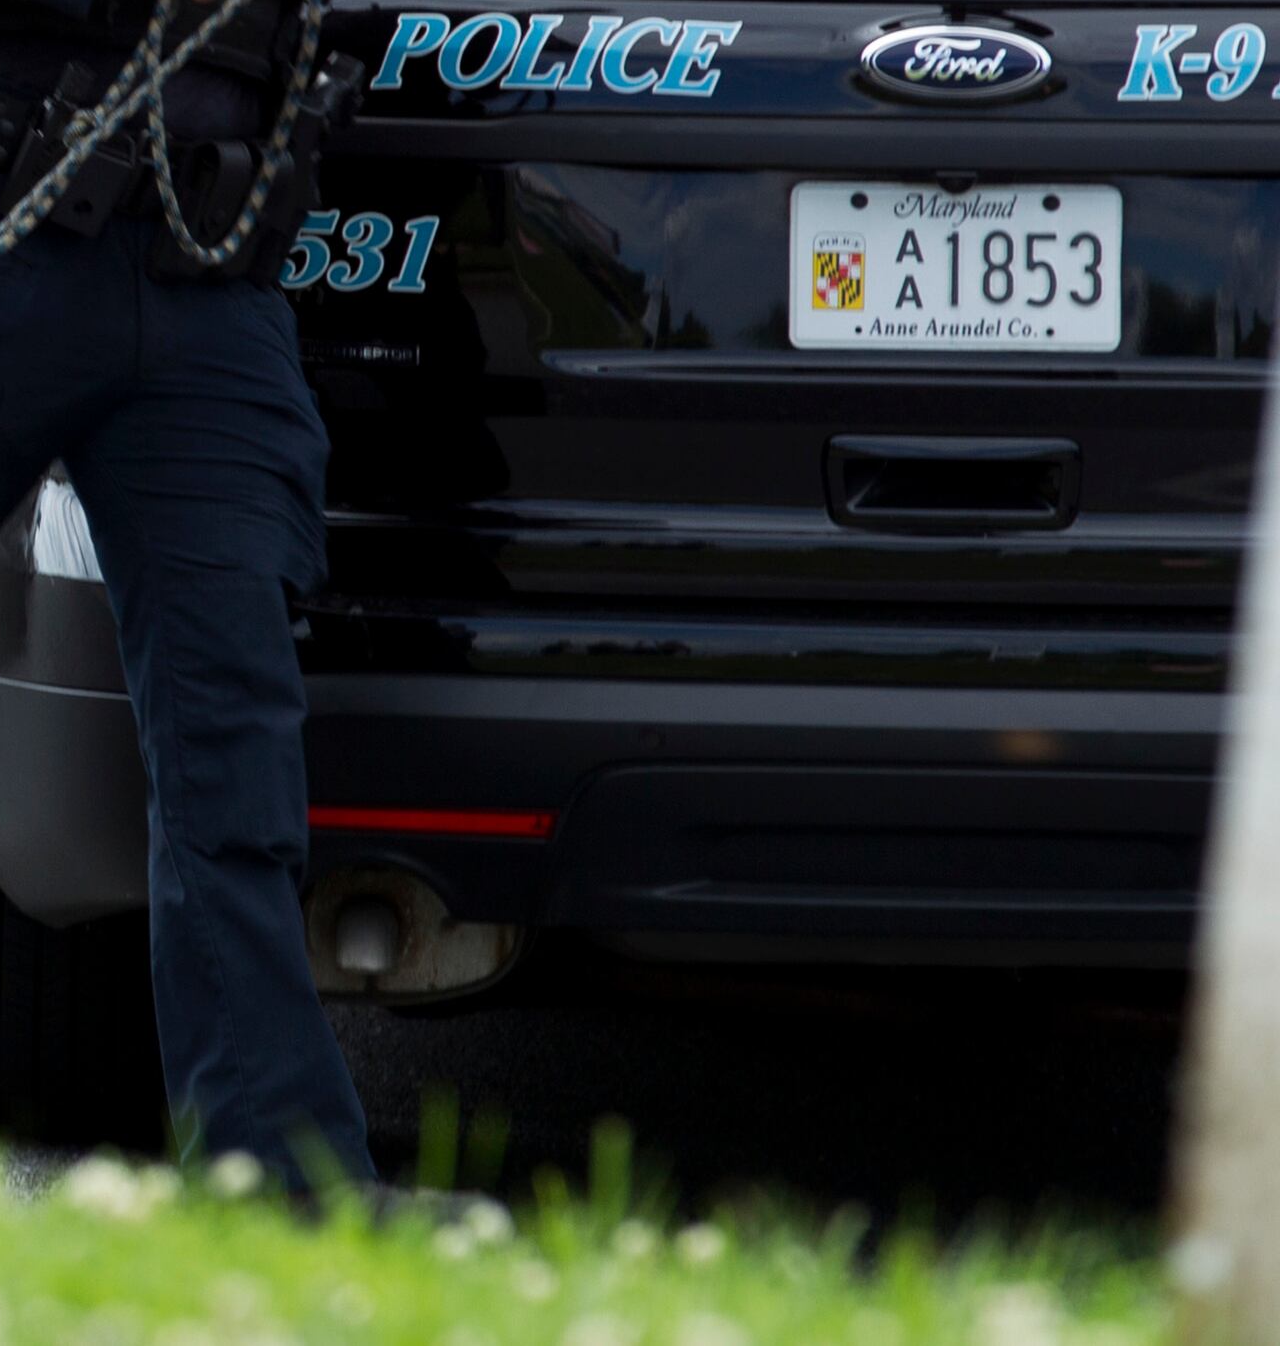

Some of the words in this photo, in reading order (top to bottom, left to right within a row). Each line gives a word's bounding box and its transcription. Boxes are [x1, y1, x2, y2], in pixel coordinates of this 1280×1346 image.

[369, 12, 743, 98] POLICE
[904, 36, 1008, 81] Ford
[1116, 22, 1267, 102] K-9
[893, 192, 1018, 229] Maryland
[278, 208, 440, 294] 531
[946, 230, 1103, 308] 1853
[869, 318, 918, 338] Anne
[925, 318, 1001, 338] Arundel
[1007, 319, 1039, 339] Co.
